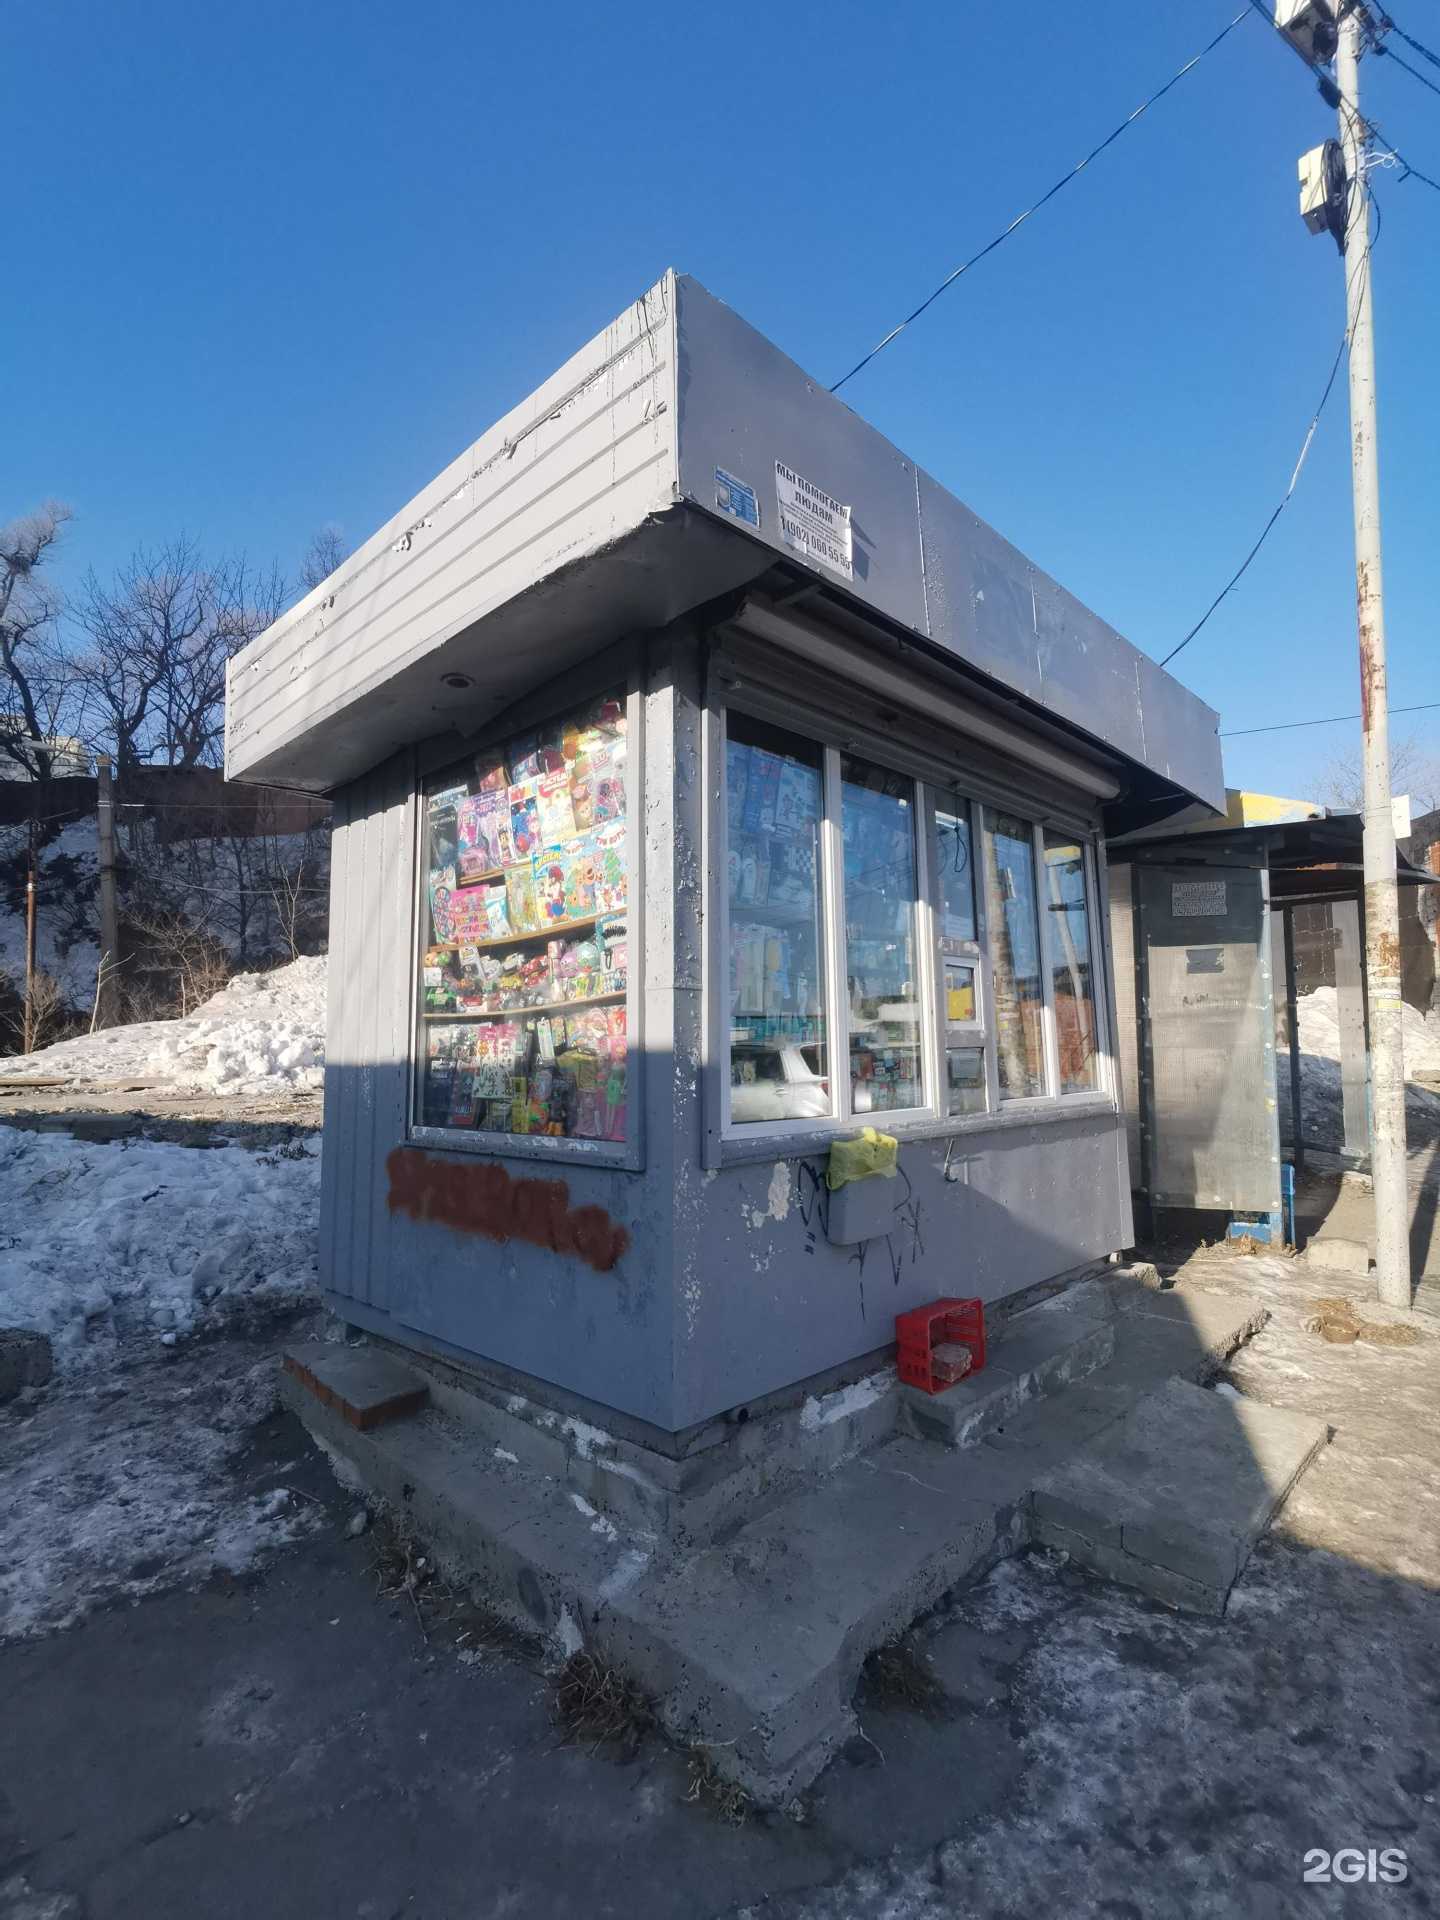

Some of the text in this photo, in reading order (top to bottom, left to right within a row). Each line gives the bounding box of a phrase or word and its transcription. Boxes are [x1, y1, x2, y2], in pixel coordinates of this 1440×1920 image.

[776, 463, 848, 520] МЫ ПОМОГАЕМ
[795, 490, 833, 525] ЛЮДЯМ
